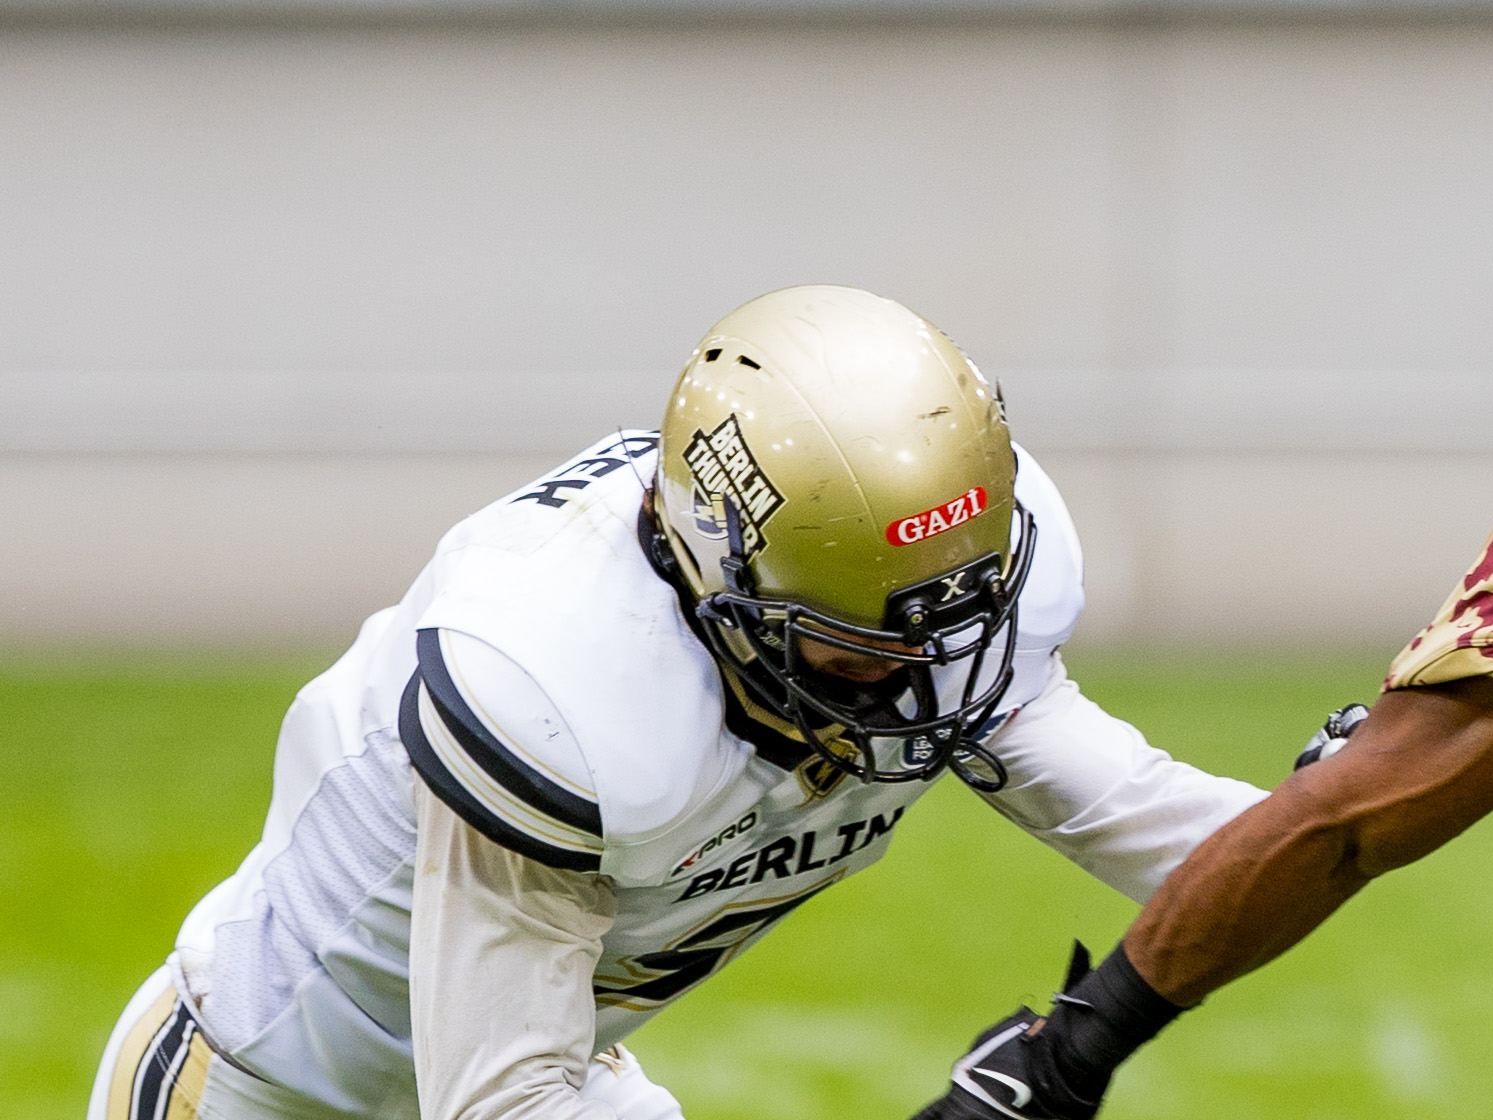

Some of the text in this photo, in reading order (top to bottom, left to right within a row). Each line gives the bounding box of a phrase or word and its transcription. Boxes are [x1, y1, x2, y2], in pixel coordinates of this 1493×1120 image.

[709, 420, 778, 523] BERLIN
[897, 487, 982, 544] GAZI
[671, 805, 906, 904] BERLIN
